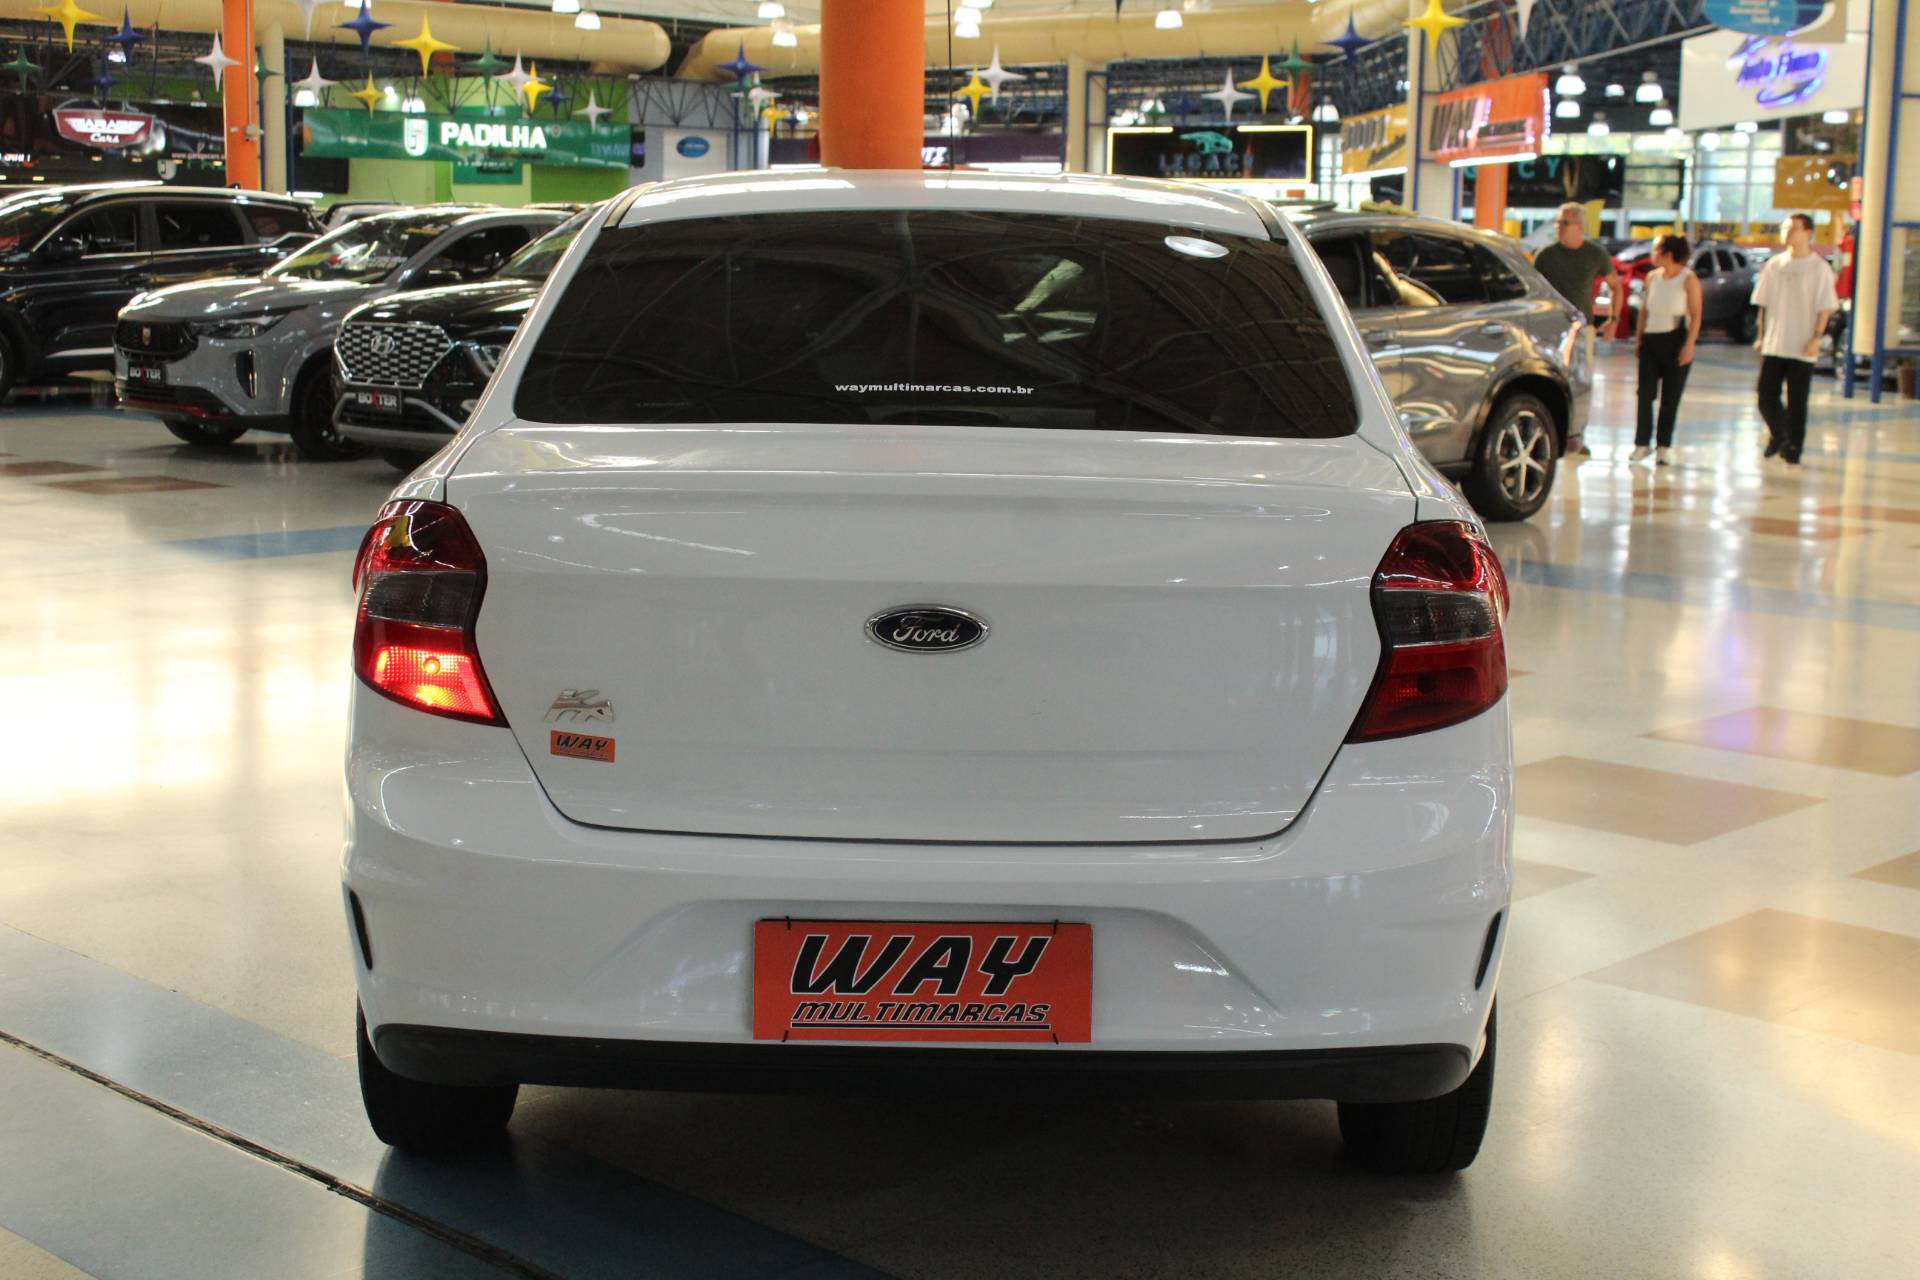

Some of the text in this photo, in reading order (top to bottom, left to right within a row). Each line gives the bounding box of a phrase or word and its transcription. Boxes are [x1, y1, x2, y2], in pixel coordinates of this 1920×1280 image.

[440, 122, 548, 149] PADILHA
[834, 383, 1034, 394] waymultimarcas.com.br
[893, 615, 960, 642] Ford
[556, 735, 608, 751] WAY
[790, 934, 1052, 996] WAY
[791, 1001, 1051, 1022] MULTIMARCAS
